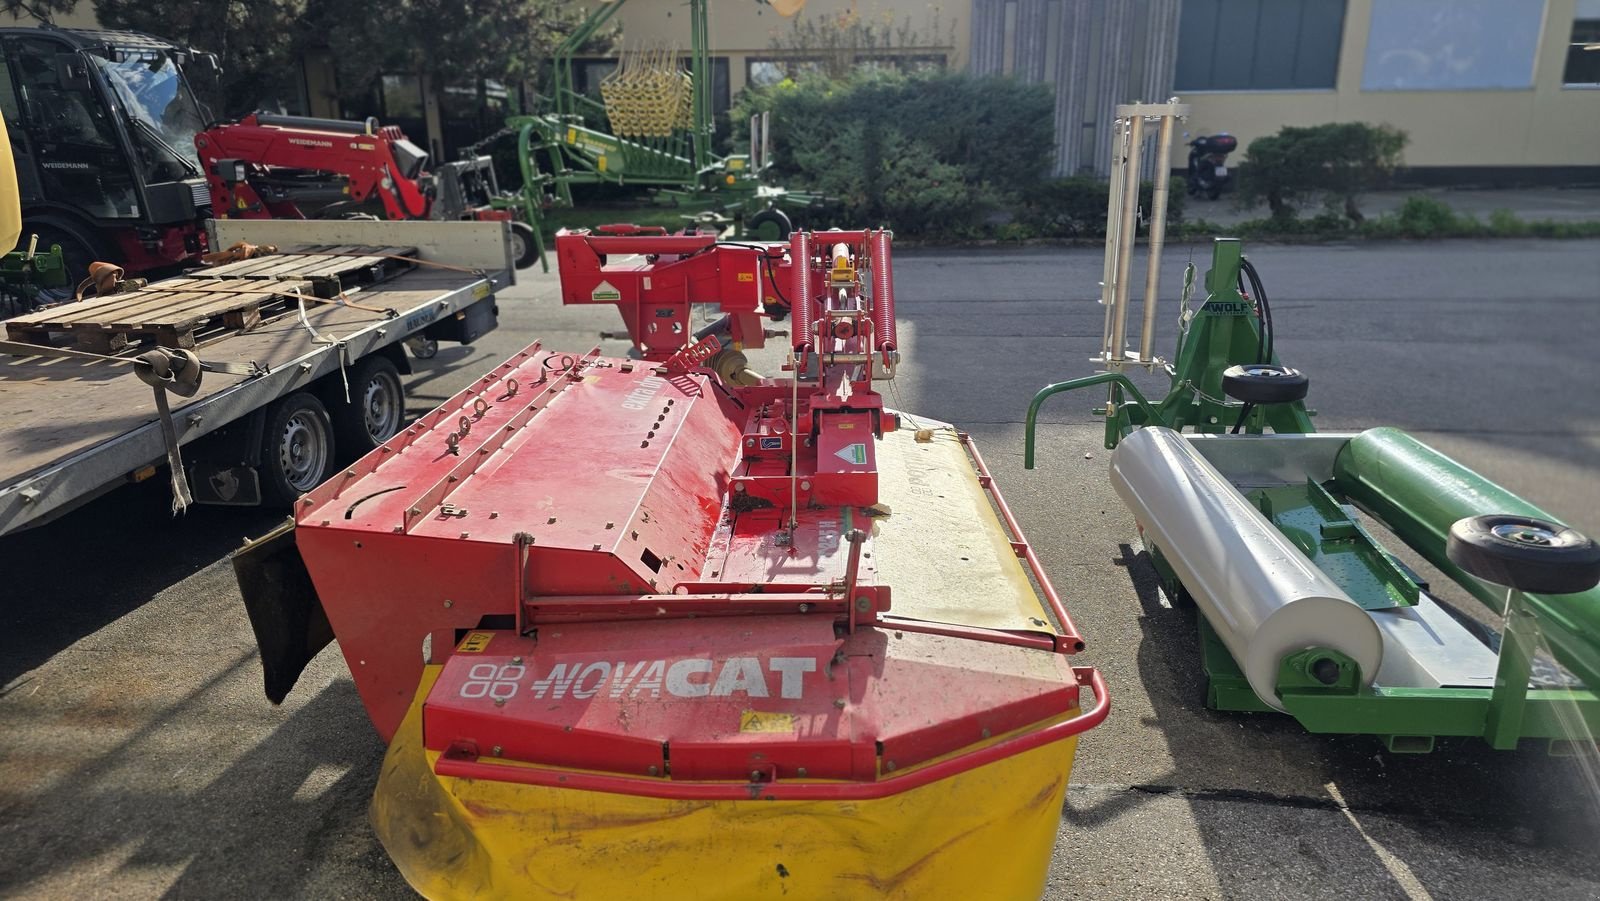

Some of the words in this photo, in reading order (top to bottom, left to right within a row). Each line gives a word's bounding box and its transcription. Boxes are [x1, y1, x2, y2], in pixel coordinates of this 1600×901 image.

[288, 138, 333, 147] WEIDEMANN
[1211, 303, 1248, 312] WOLF
[530, 657, 817, 699] NOVACAT
